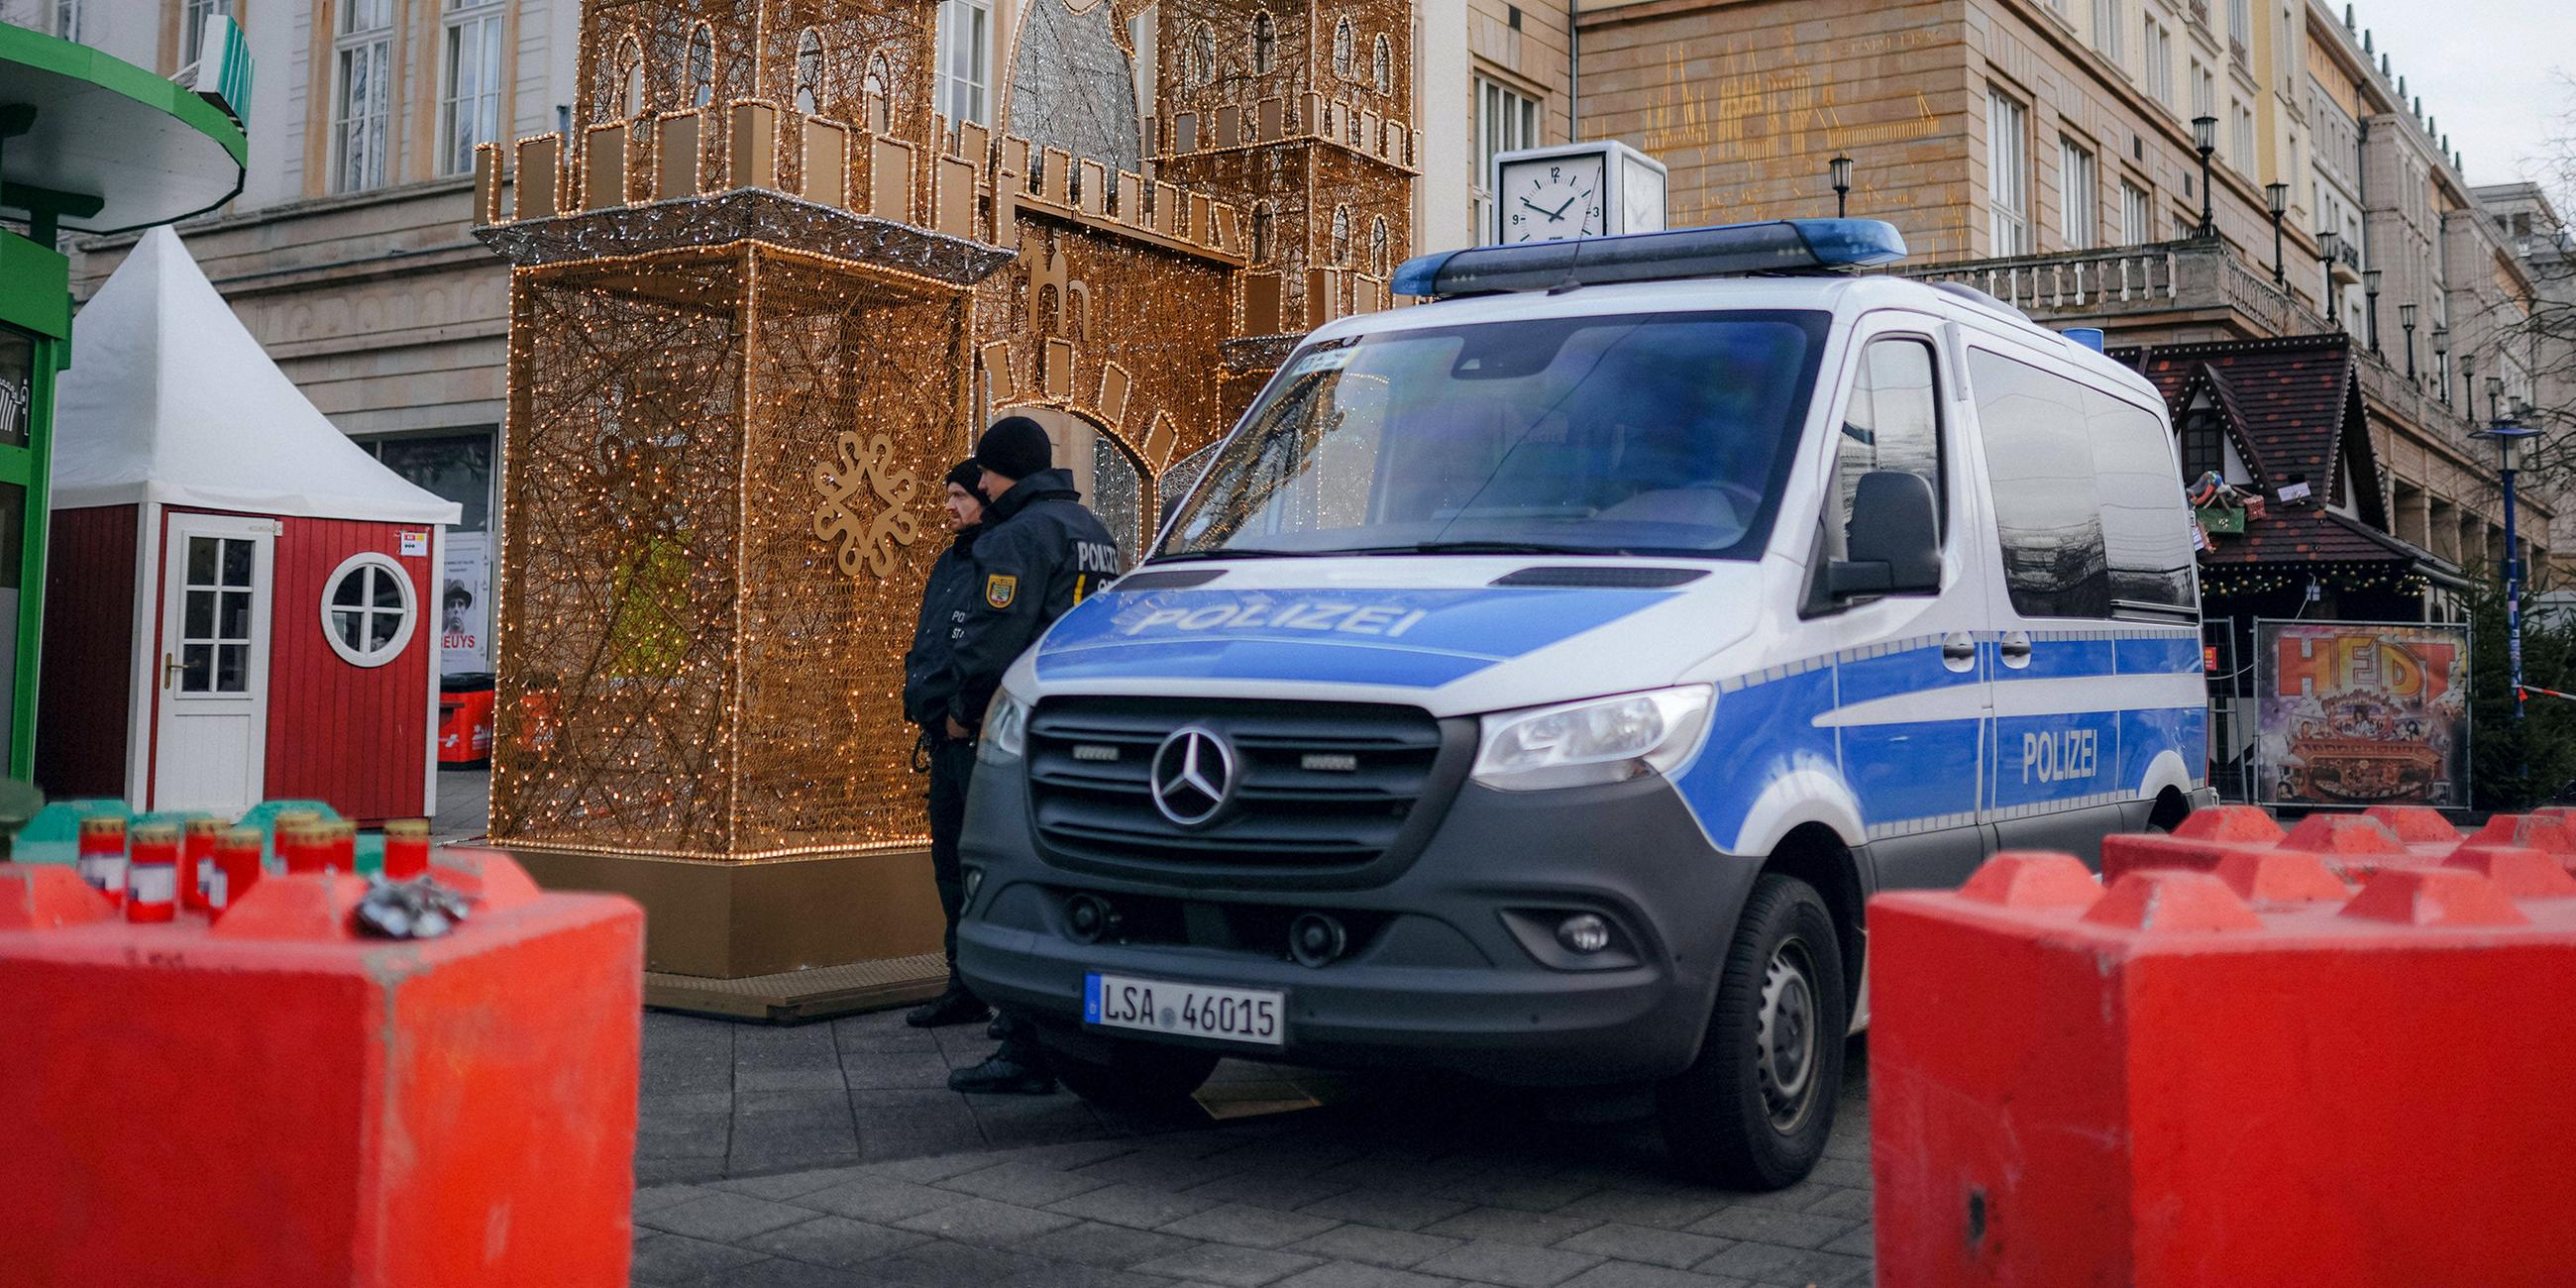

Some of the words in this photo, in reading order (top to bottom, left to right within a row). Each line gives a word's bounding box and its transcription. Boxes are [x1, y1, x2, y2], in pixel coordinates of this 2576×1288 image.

[1551, 166, 1560, 178] 12
[1512, 214, 1519, 226] 9
[1592, 207, 1600, 218] 3
[1124, 603, 1427, 637] POLIZEI
[441, 634, 475, 649] EUYS
[2023, 729, 2097, 785] POLIZEI
[1105, 984, 1155, 1025] LSA
[1182, 993, 1275, 1037] 46015
